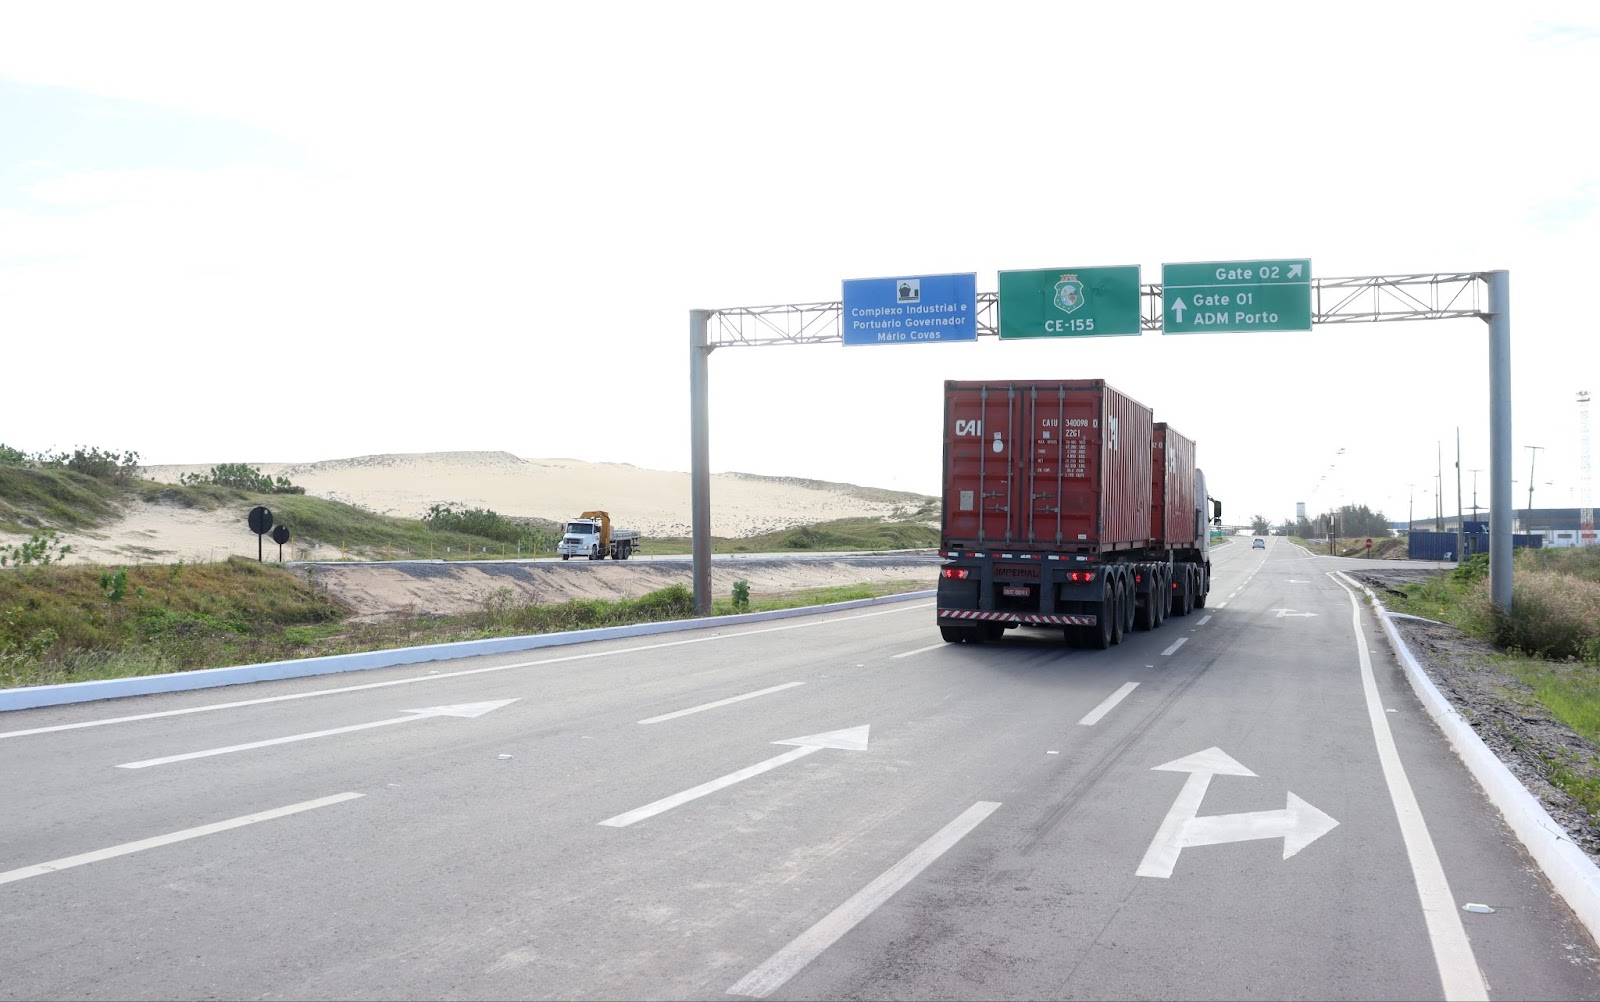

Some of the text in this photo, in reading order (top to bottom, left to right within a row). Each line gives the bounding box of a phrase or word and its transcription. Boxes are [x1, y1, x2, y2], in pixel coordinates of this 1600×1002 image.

[1215, 266, 1280, 280] Gate 02
[1193, 292, 1253, 306] Gate 01
[852, 306, 902, 318] Complexo
[906, 303, 957, 315] Industrial
[853, 316, 966, 330] Portuário Governador
[1044, 318, 1095, 332] CE-155
[1193, 311, 1279, 325] ADM Porto
[877, 330, 941, 341] Mário Covas
[955, 419, 982, 436] CAI
[1042, 419, 1058, 427] CAIU
[1065, 419, 1088, 427] 340098
[1065, 429, 1080, 437] 22G1
[995, 569, 1038, 577] IMPERIAL
